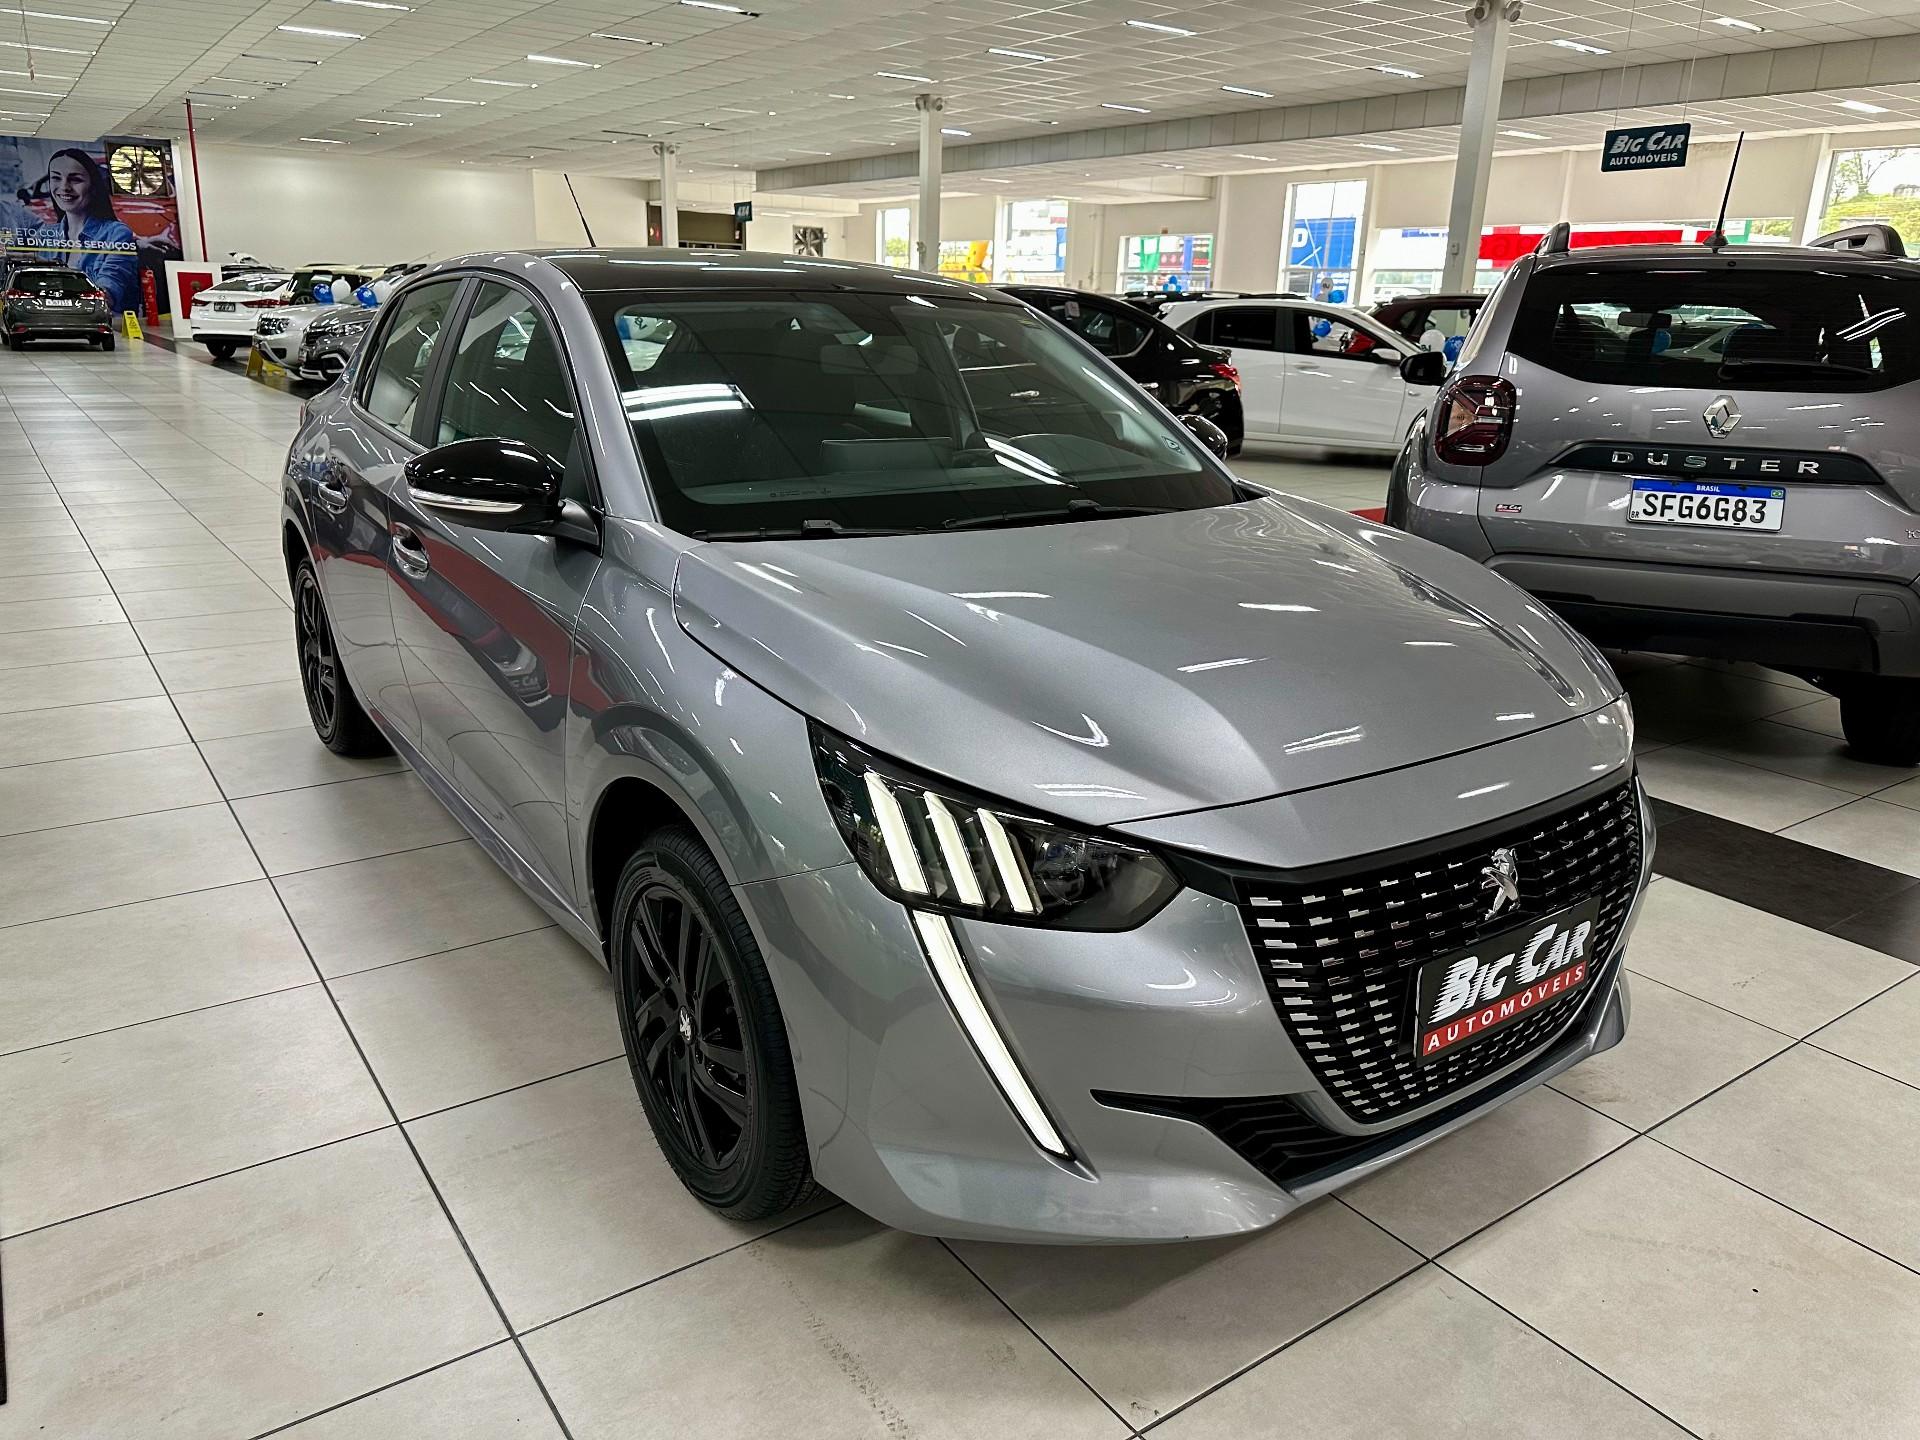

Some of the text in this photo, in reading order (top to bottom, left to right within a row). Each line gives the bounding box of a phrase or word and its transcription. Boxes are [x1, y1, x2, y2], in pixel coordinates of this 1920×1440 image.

[1609, 131, 1686, 154] BIG CAR
[1610, 152, 1678, 166] AUTOMÓVEIS
[17, 237, 25, 245] E
[27, 237, 82, 248] DIVERSOS
[84, 240, 137, 251] SERVIÇOS
[39, 229, 65, 238] COM
[1611, 450, 1820, 475] DUSTER
[1696, 484, 1720, 493] BRASIL
[1642, 493, 1767, 524] SFG6G83
[1428, 920, 1591, 1024] BIG CAR
[1427, 965, 1584, 1051] AUTOMÓVEIS
